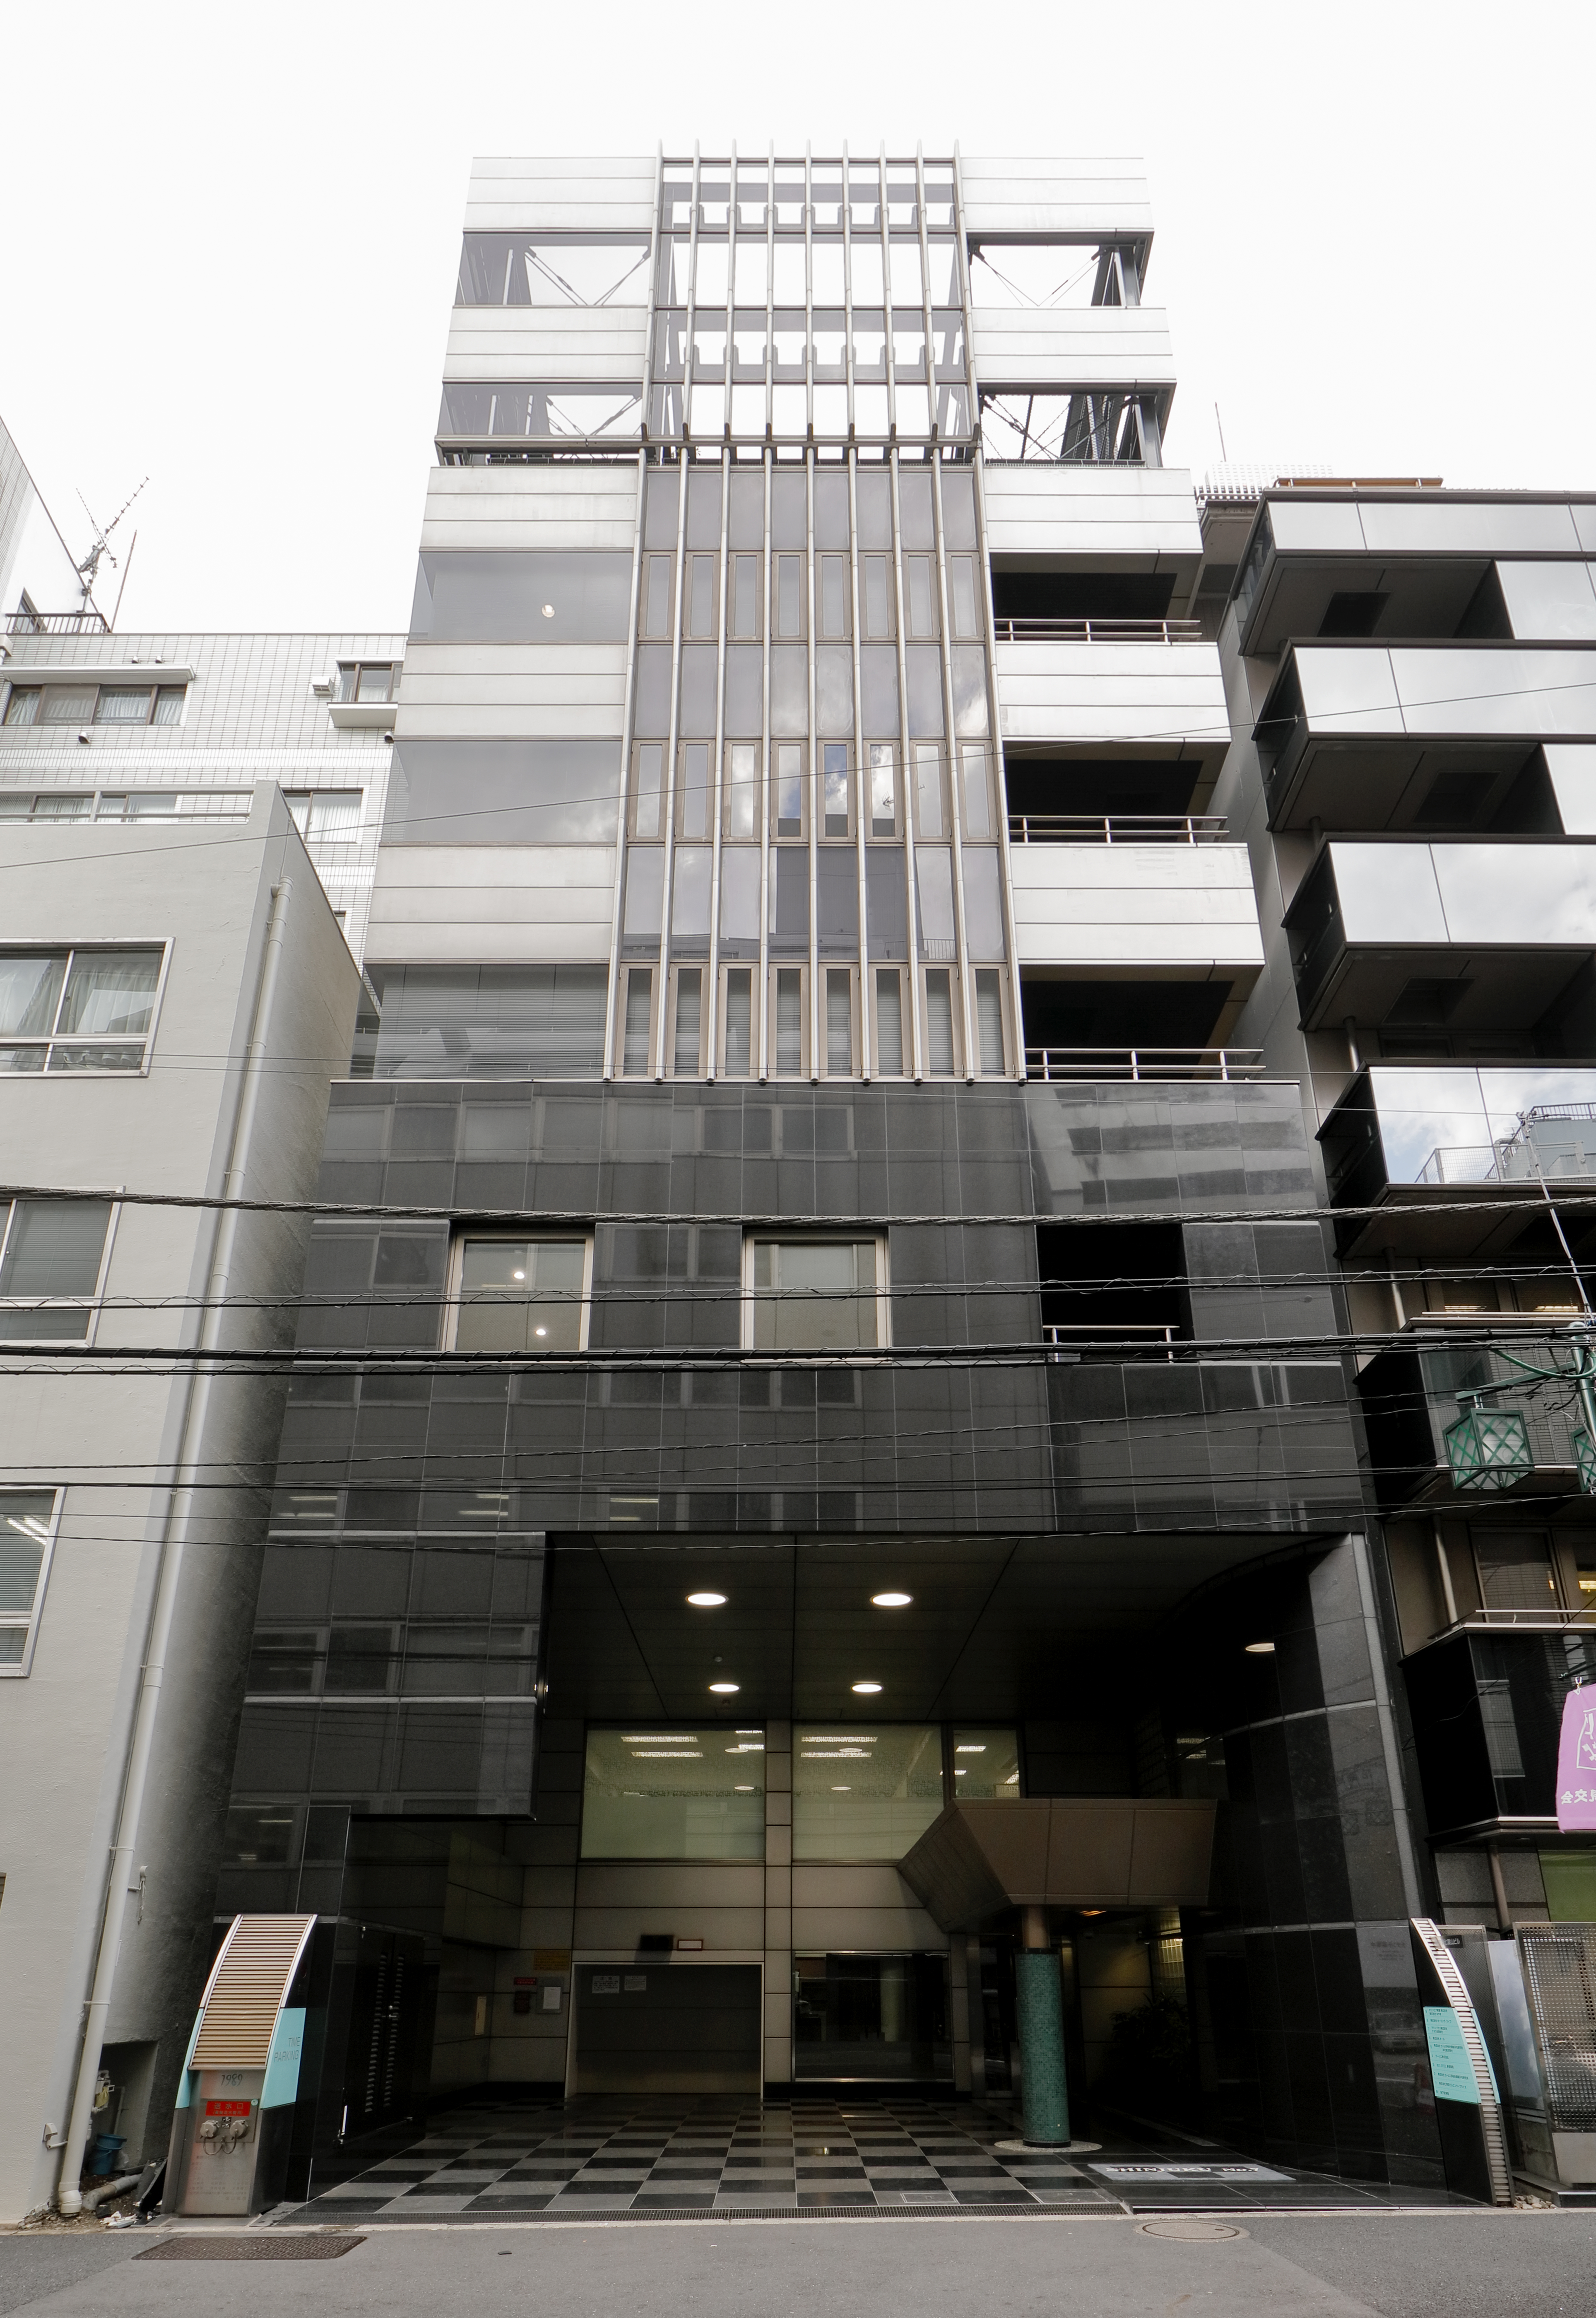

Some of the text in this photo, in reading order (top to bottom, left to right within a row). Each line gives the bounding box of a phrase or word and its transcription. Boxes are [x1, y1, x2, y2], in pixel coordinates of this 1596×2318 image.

[288, 2037, 301, 2047] TIME
[273, 2050, 299, 2063] PARKING
[221, 2074, 243, 2087] 1989
